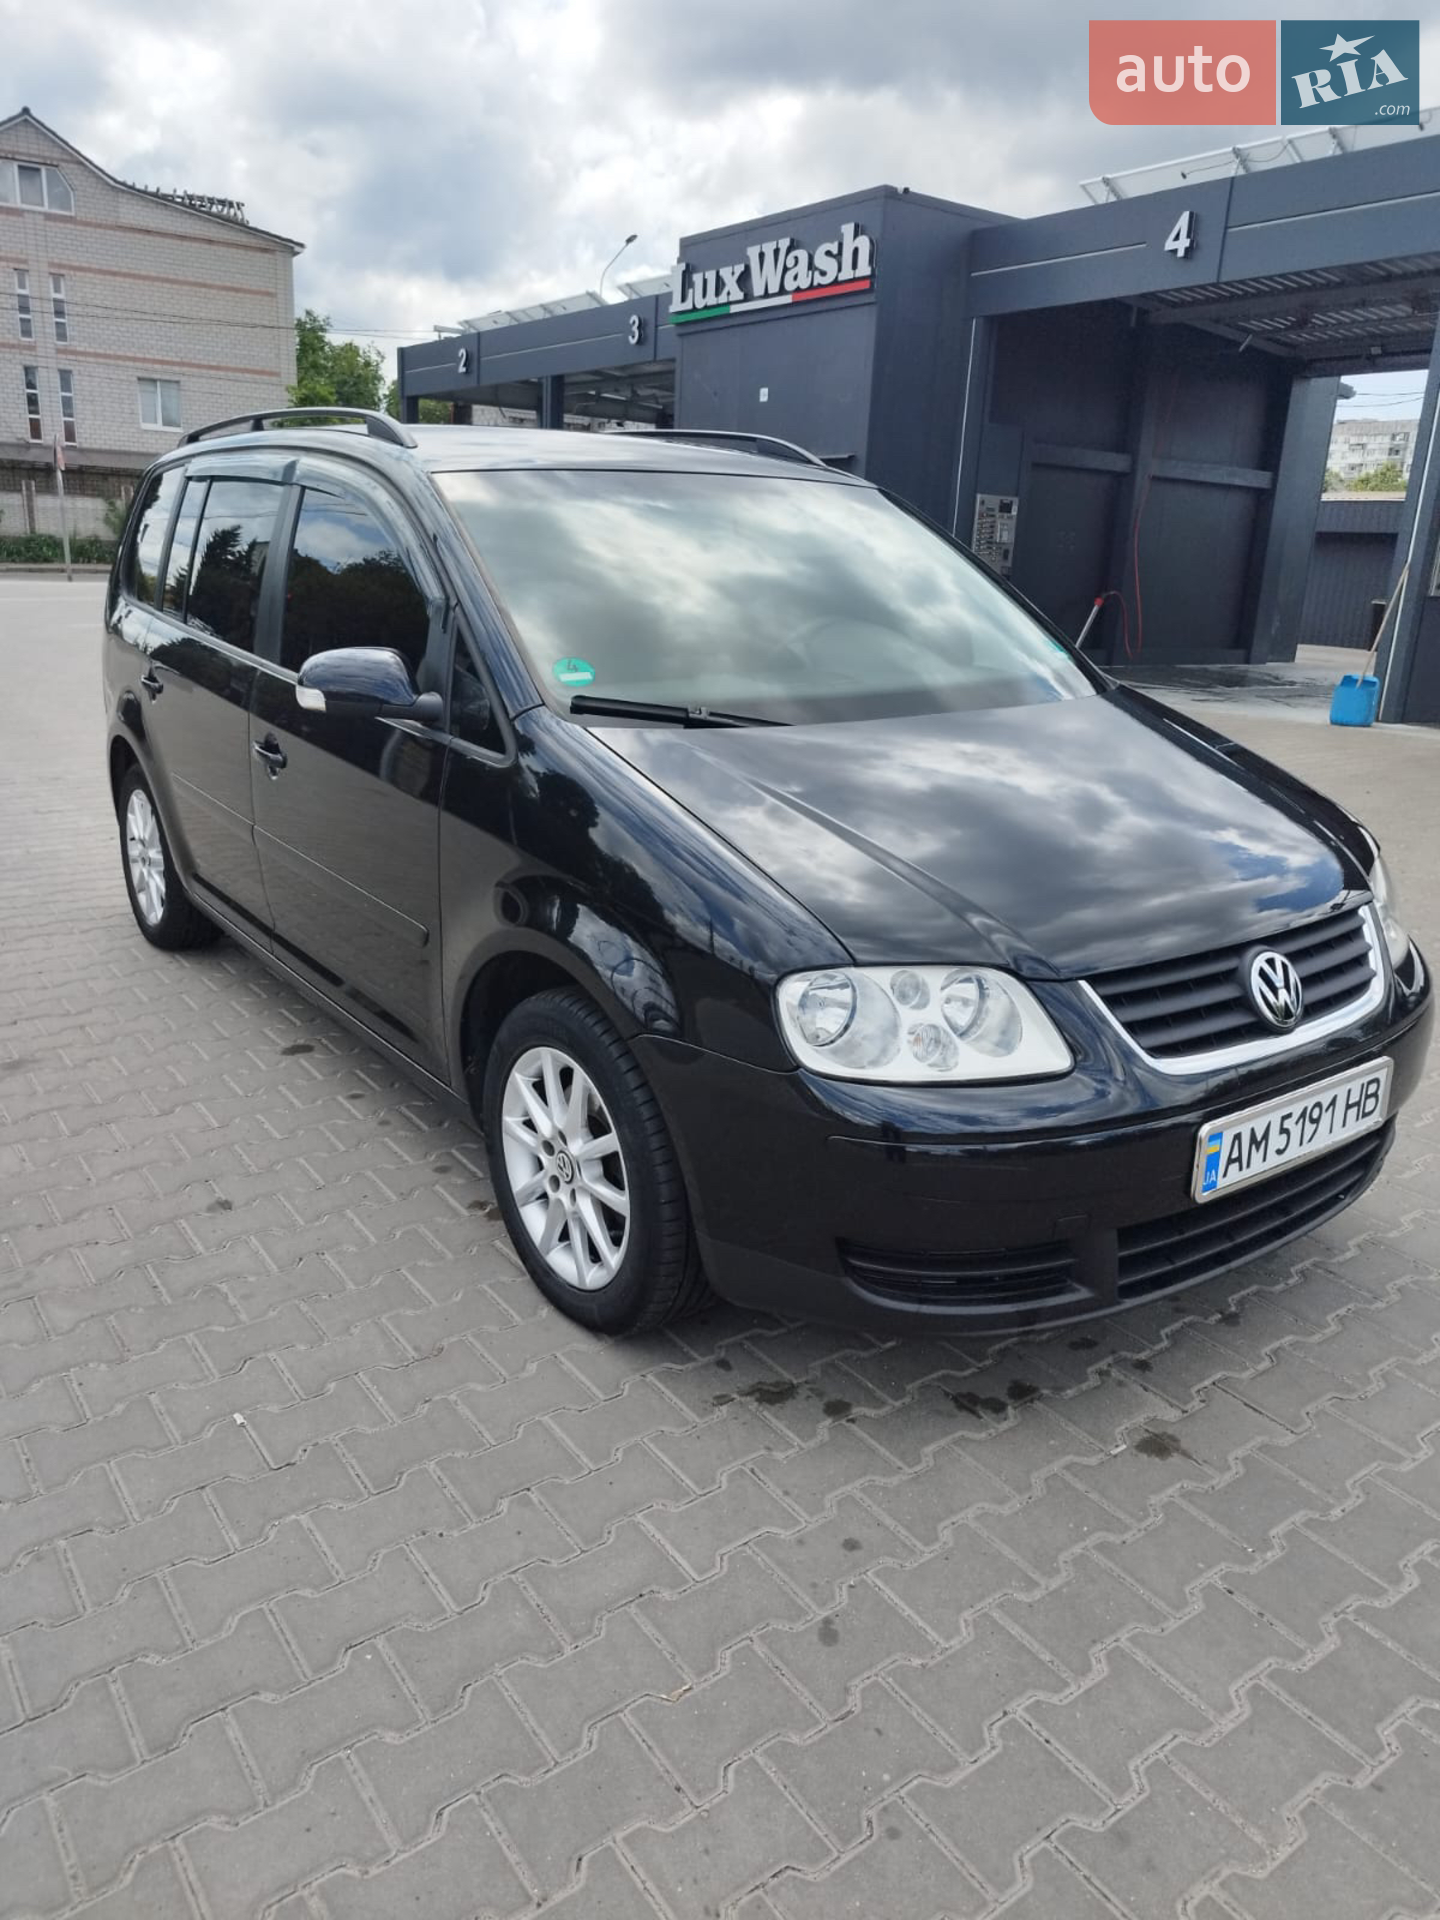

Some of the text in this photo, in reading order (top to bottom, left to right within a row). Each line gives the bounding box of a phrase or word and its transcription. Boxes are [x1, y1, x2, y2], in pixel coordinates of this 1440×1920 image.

[1164, 210, 1191, 258] 4
[628, 314, 641, 346] 3
[457, 348, 468, 373] 2
[1222, 1077, 1381, 1178] AM 5191 HB
